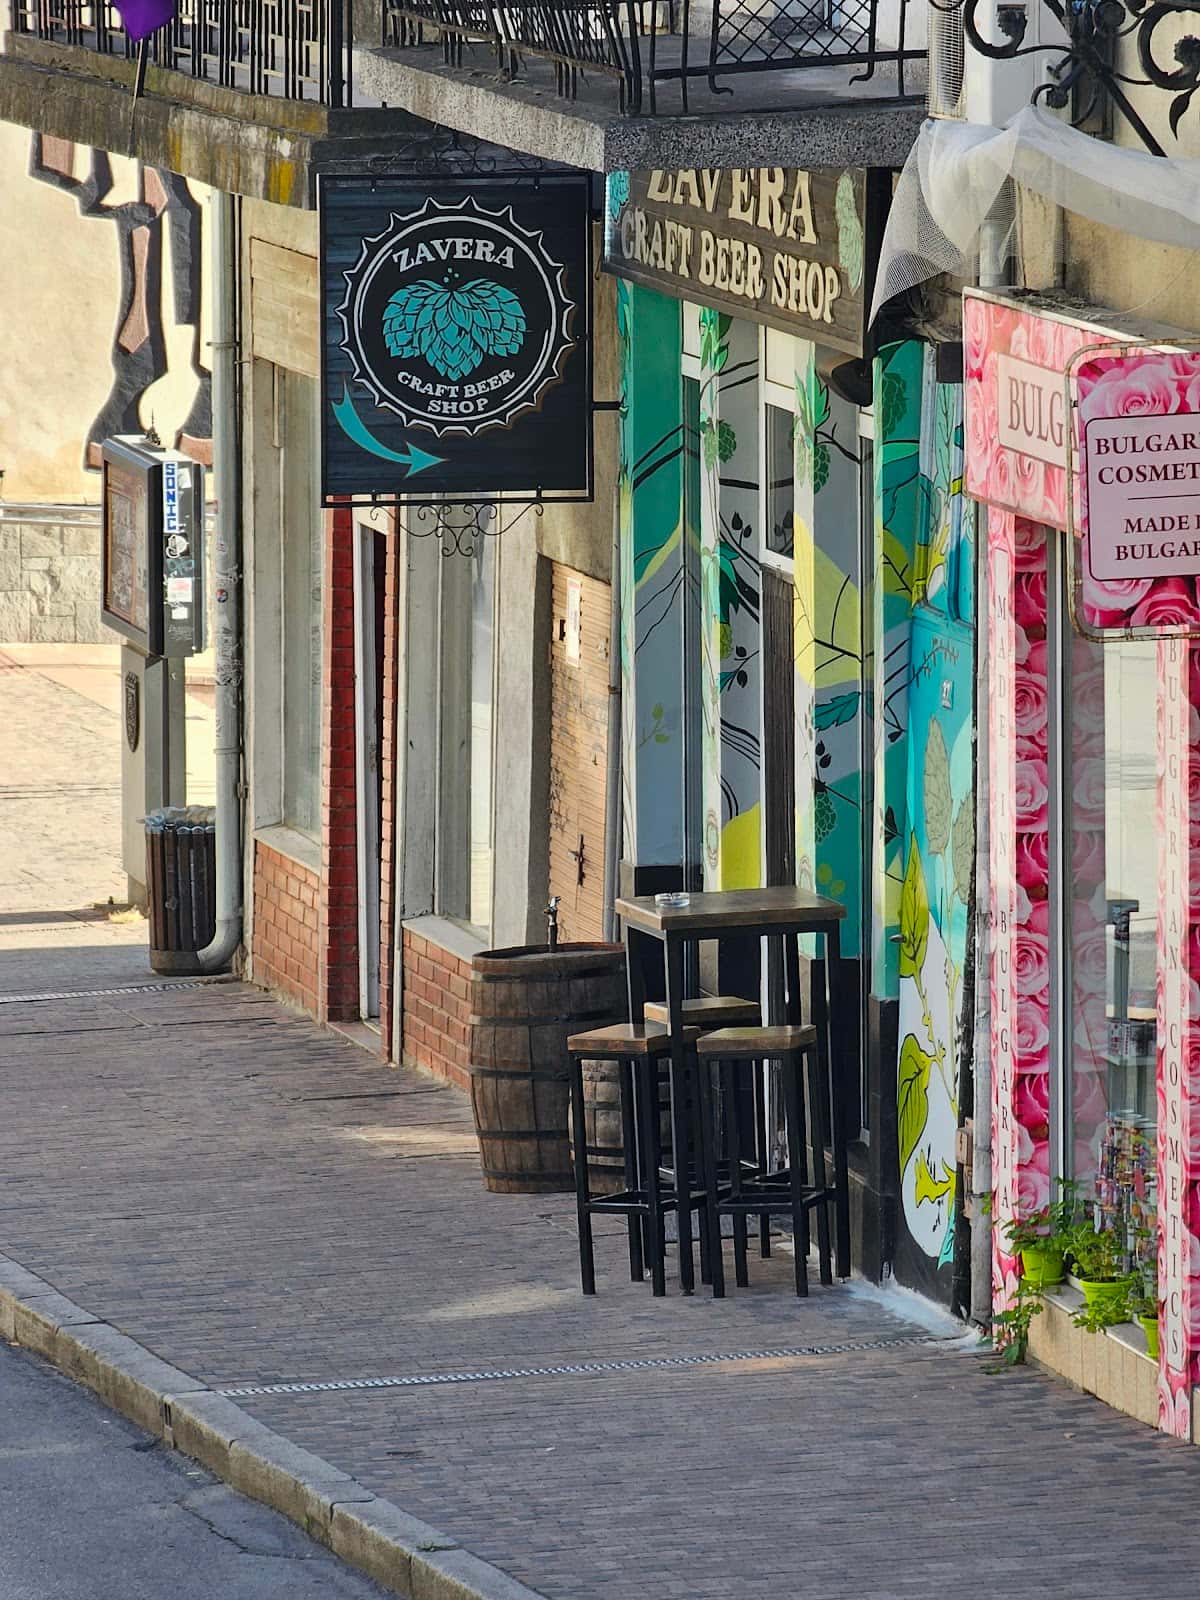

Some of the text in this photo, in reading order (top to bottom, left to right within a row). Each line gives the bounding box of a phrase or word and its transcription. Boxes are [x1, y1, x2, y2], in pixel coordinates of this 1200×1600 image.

[392, 238, 515, 272] ZAVERA
[621, 208, 841, 323] CRAFT BEER SHOP
[397, 369, 516, 398] CRAFT BEER
[427, 398, 489, 414] SHOP
[1095, 432, 1200, 455] BULGAR
[1098, 462, 1200, 485] COSMET
[1124, 514, 1190, 534] MADE
[997, 595, 1009, 1209] MADE IN BULGARIA
[1168, 638, 1180, 1354] BULGARIAN COSMETICS
